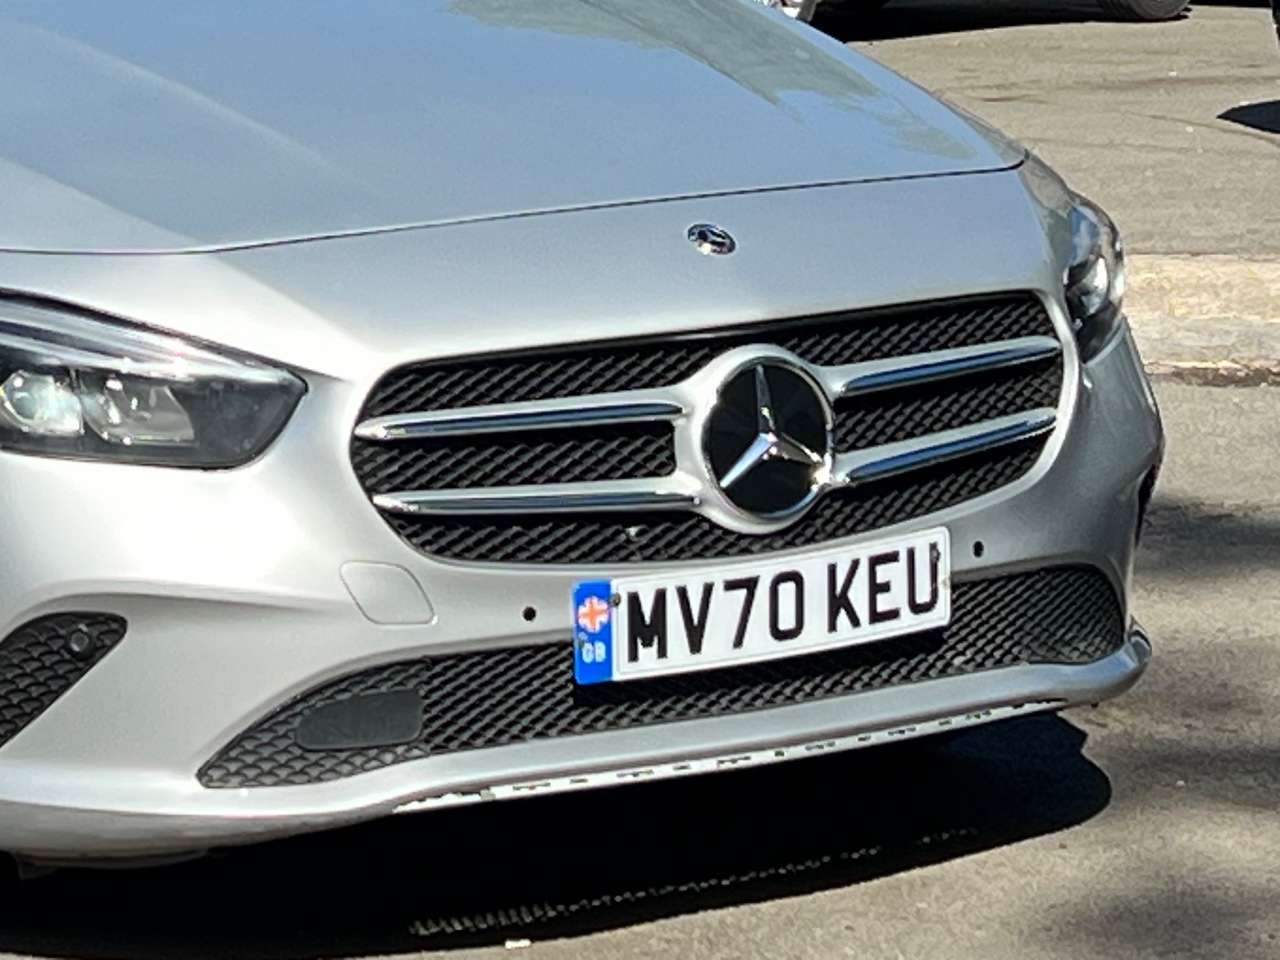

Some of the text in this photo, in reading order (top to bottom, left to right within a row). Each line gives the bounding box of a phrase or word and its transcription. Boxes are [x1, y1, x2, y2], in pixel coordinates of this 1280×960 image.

[626, 541, 940, 664] MV70 KEU
[582, 642, 607, 664] GB
